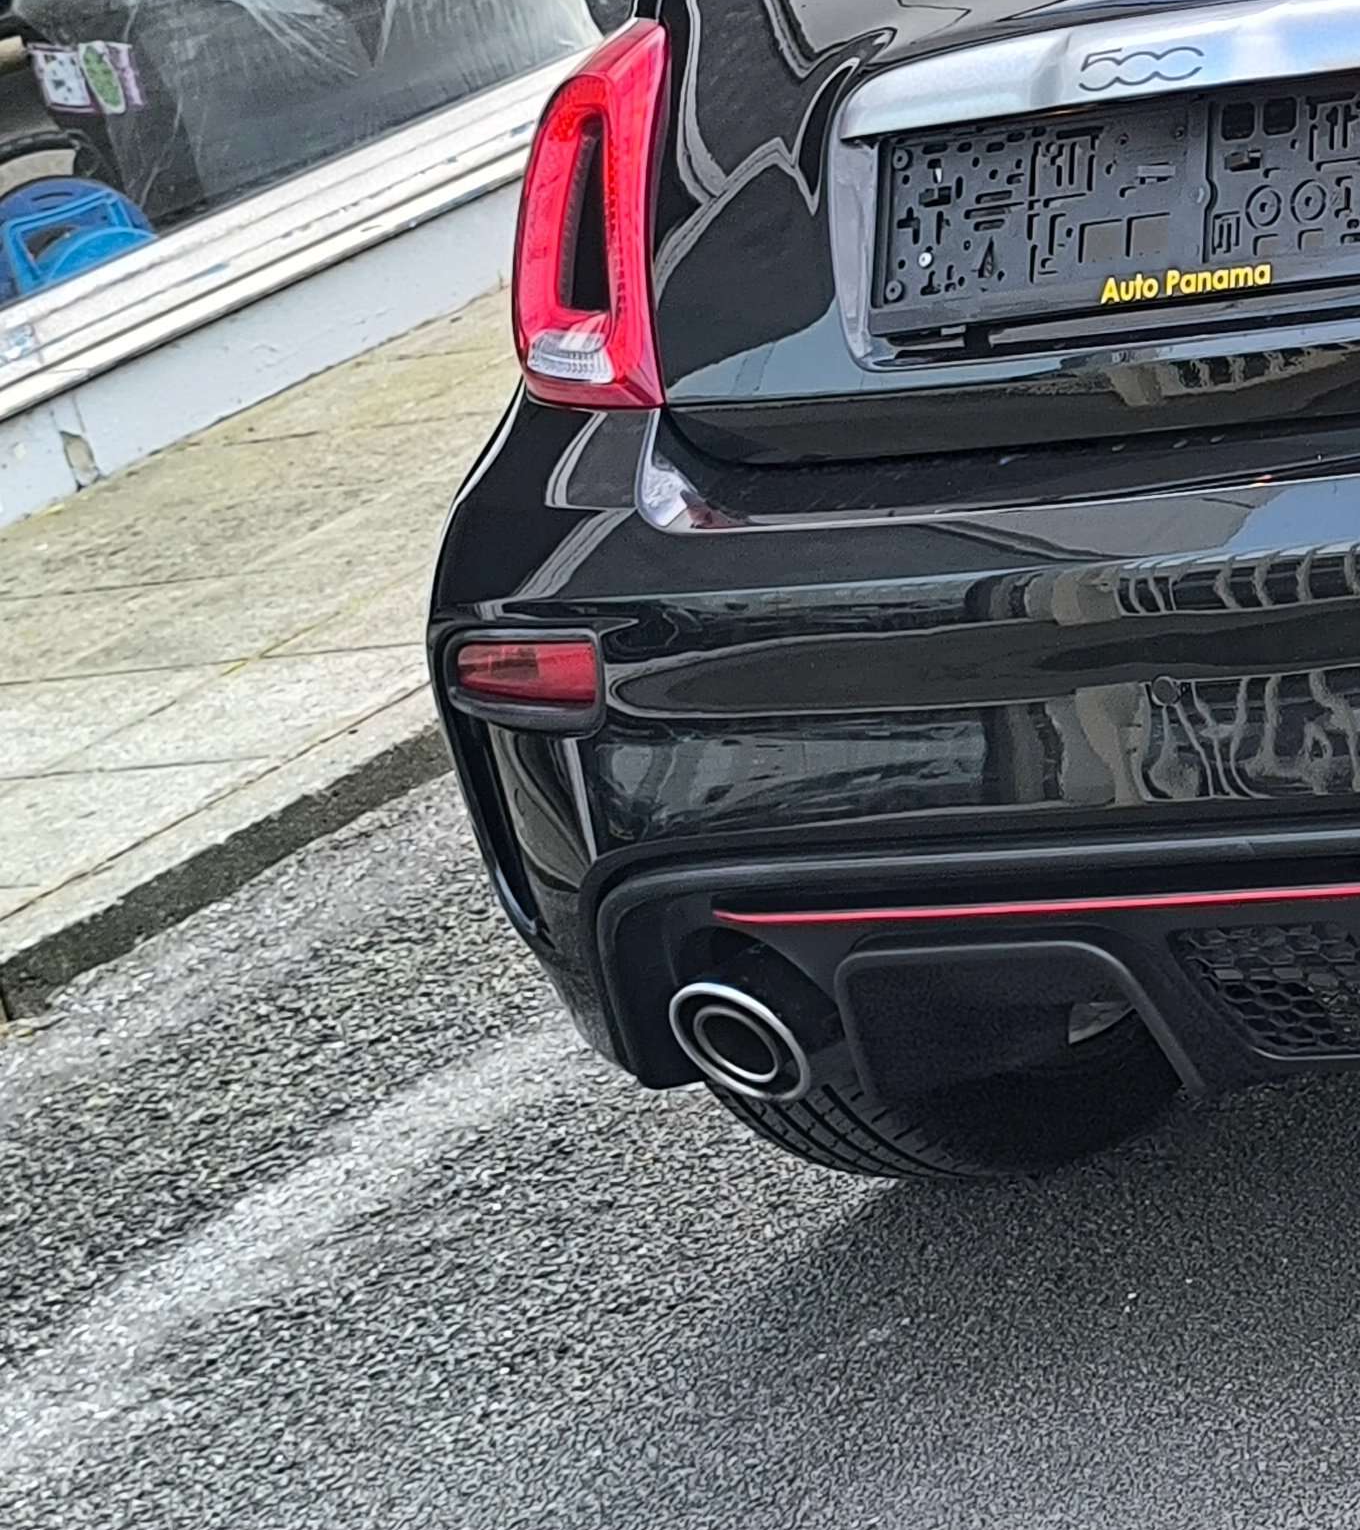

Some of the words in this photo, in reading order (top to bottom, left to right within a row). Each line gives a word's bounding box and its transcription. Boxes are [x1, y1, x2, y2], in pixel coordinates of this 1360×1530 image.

[1078, 46, 1204, 92] 500
[1100, 273, 1159, 305] Auto
[1165, 264, 1272, 297] Panama
